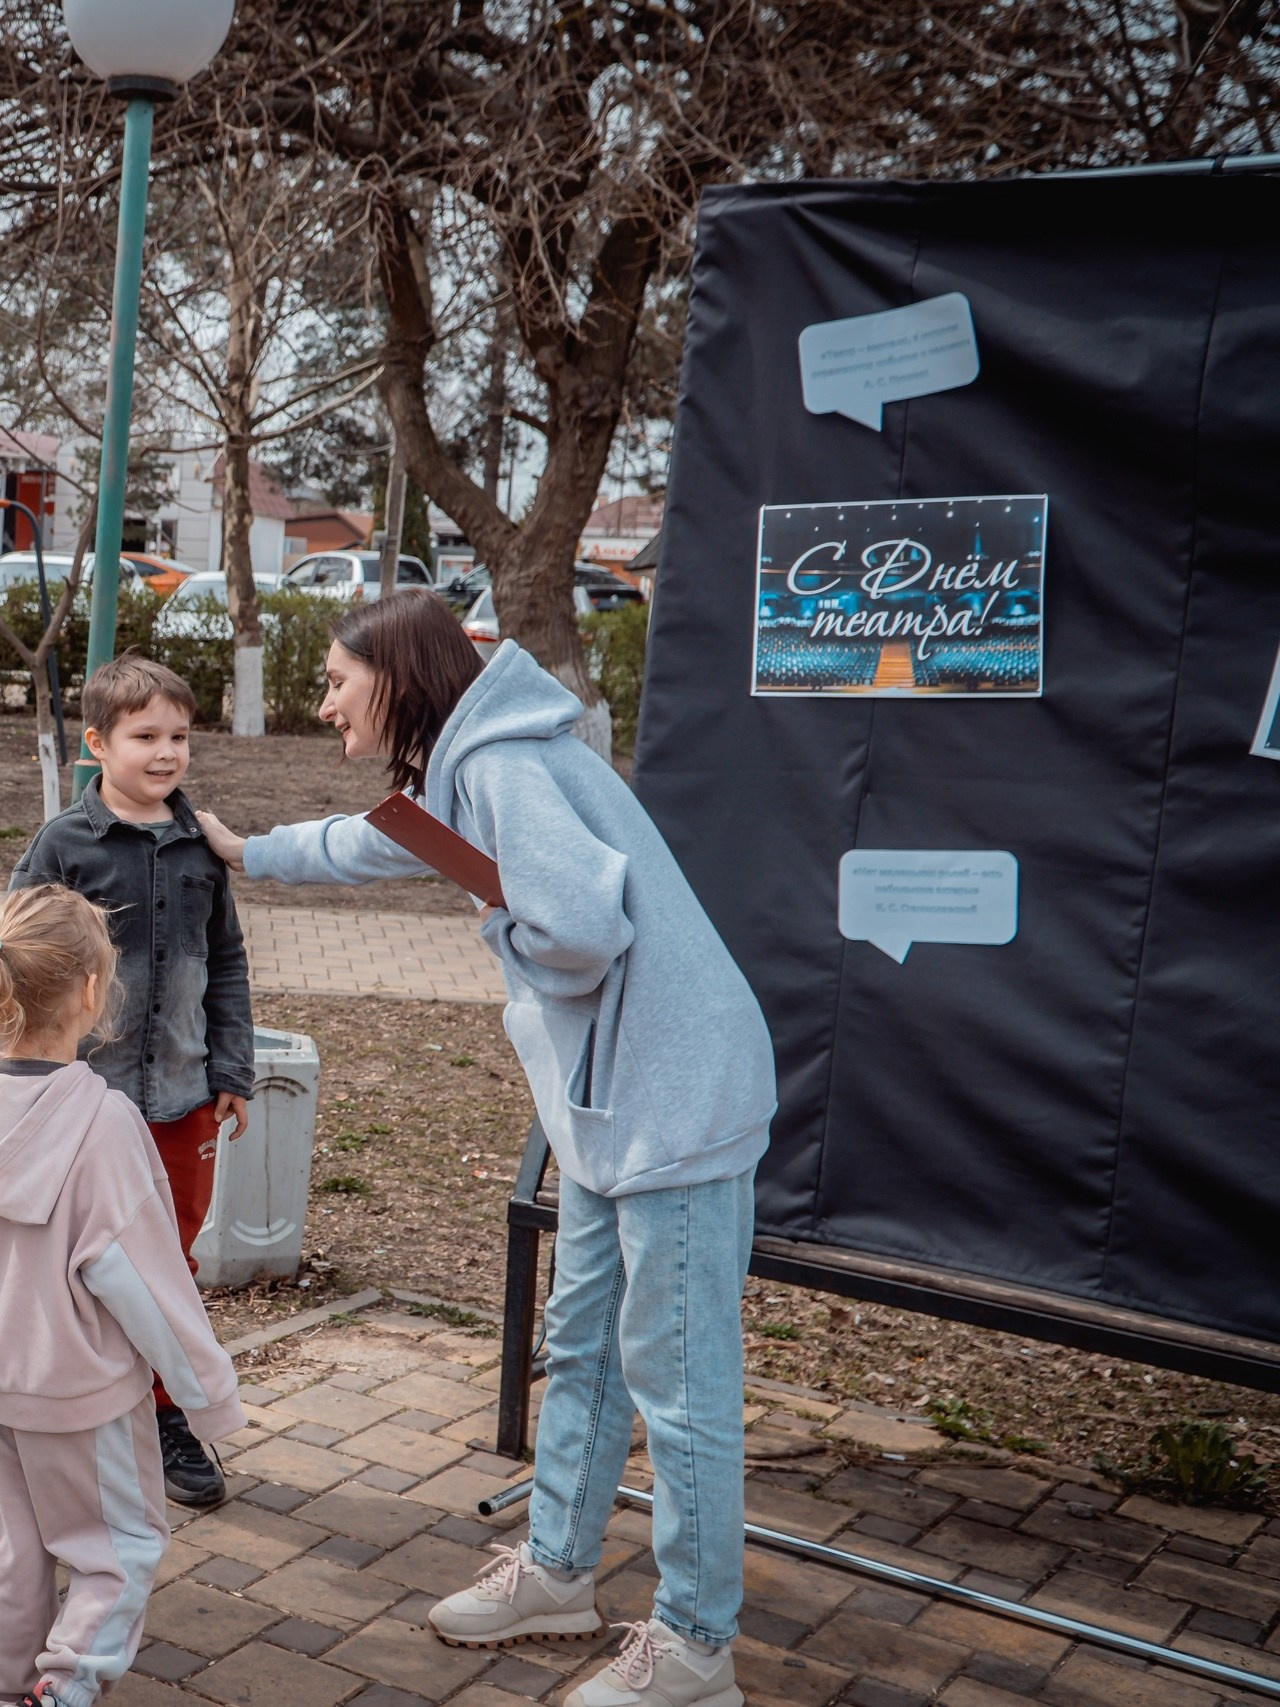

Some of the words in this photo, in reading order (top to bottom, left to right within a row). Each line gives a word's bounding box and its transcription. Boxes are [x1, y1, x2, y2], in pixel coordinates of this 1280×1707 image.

[786, 540, 847, 595] С
[860, 538, 1019, 600] Днём
[811, 590, 1000, 660] театра!
